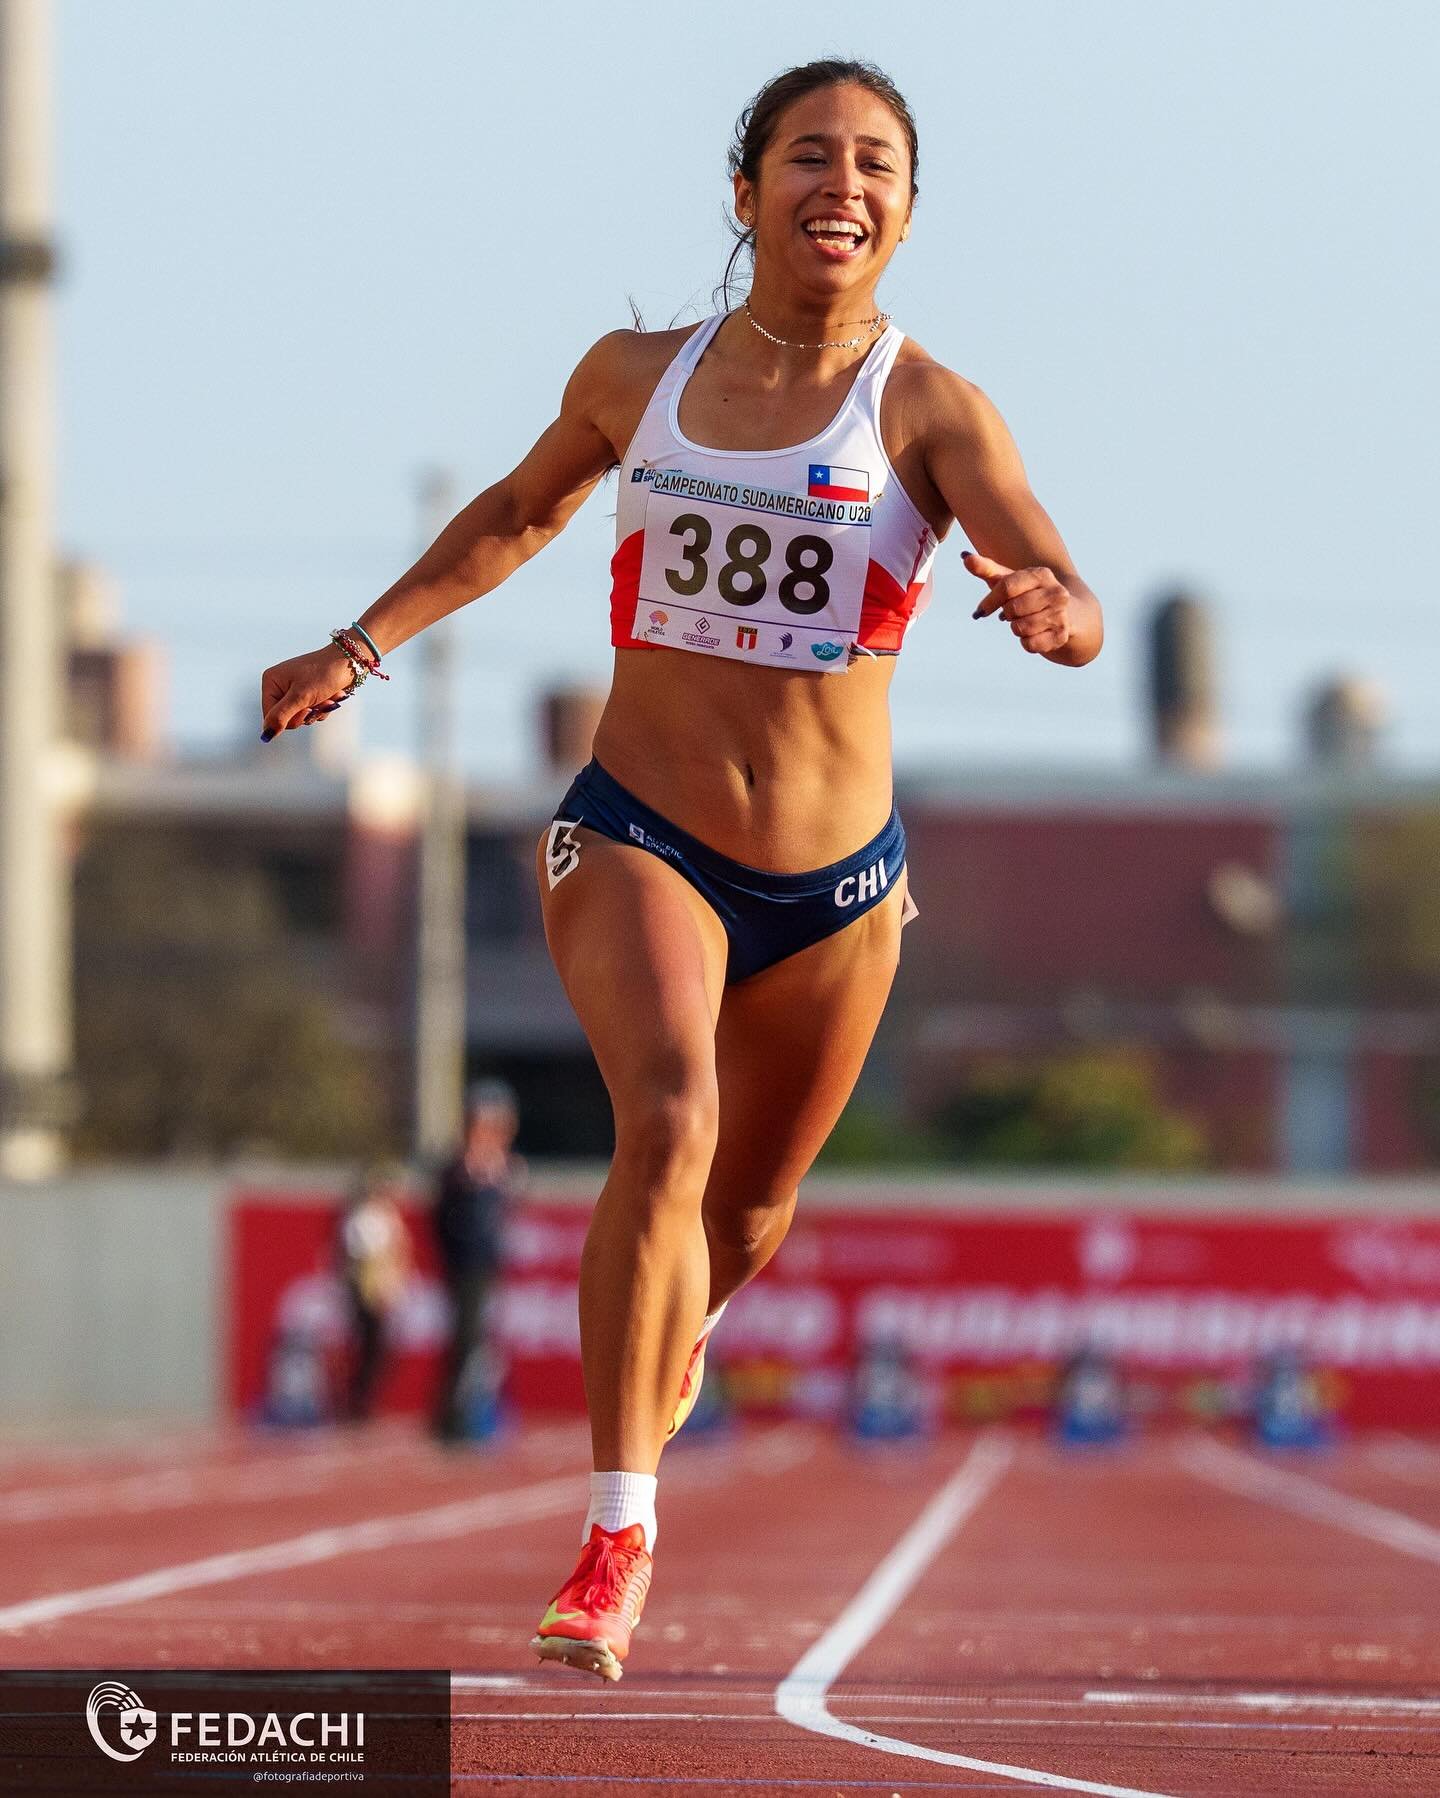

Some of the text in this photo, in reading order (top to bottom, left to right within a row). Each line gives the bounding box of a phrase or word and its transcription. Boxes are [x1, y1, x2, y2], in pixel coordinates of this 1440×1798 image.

[654, 473, 738, 502] CAMPEONATO
[741, 488, 845, 521] SUDAMERICANO
[849, 506, 871, 522] U20
[665, 513, 834, 615] 388
[834, 857, 888, 908] CHI
